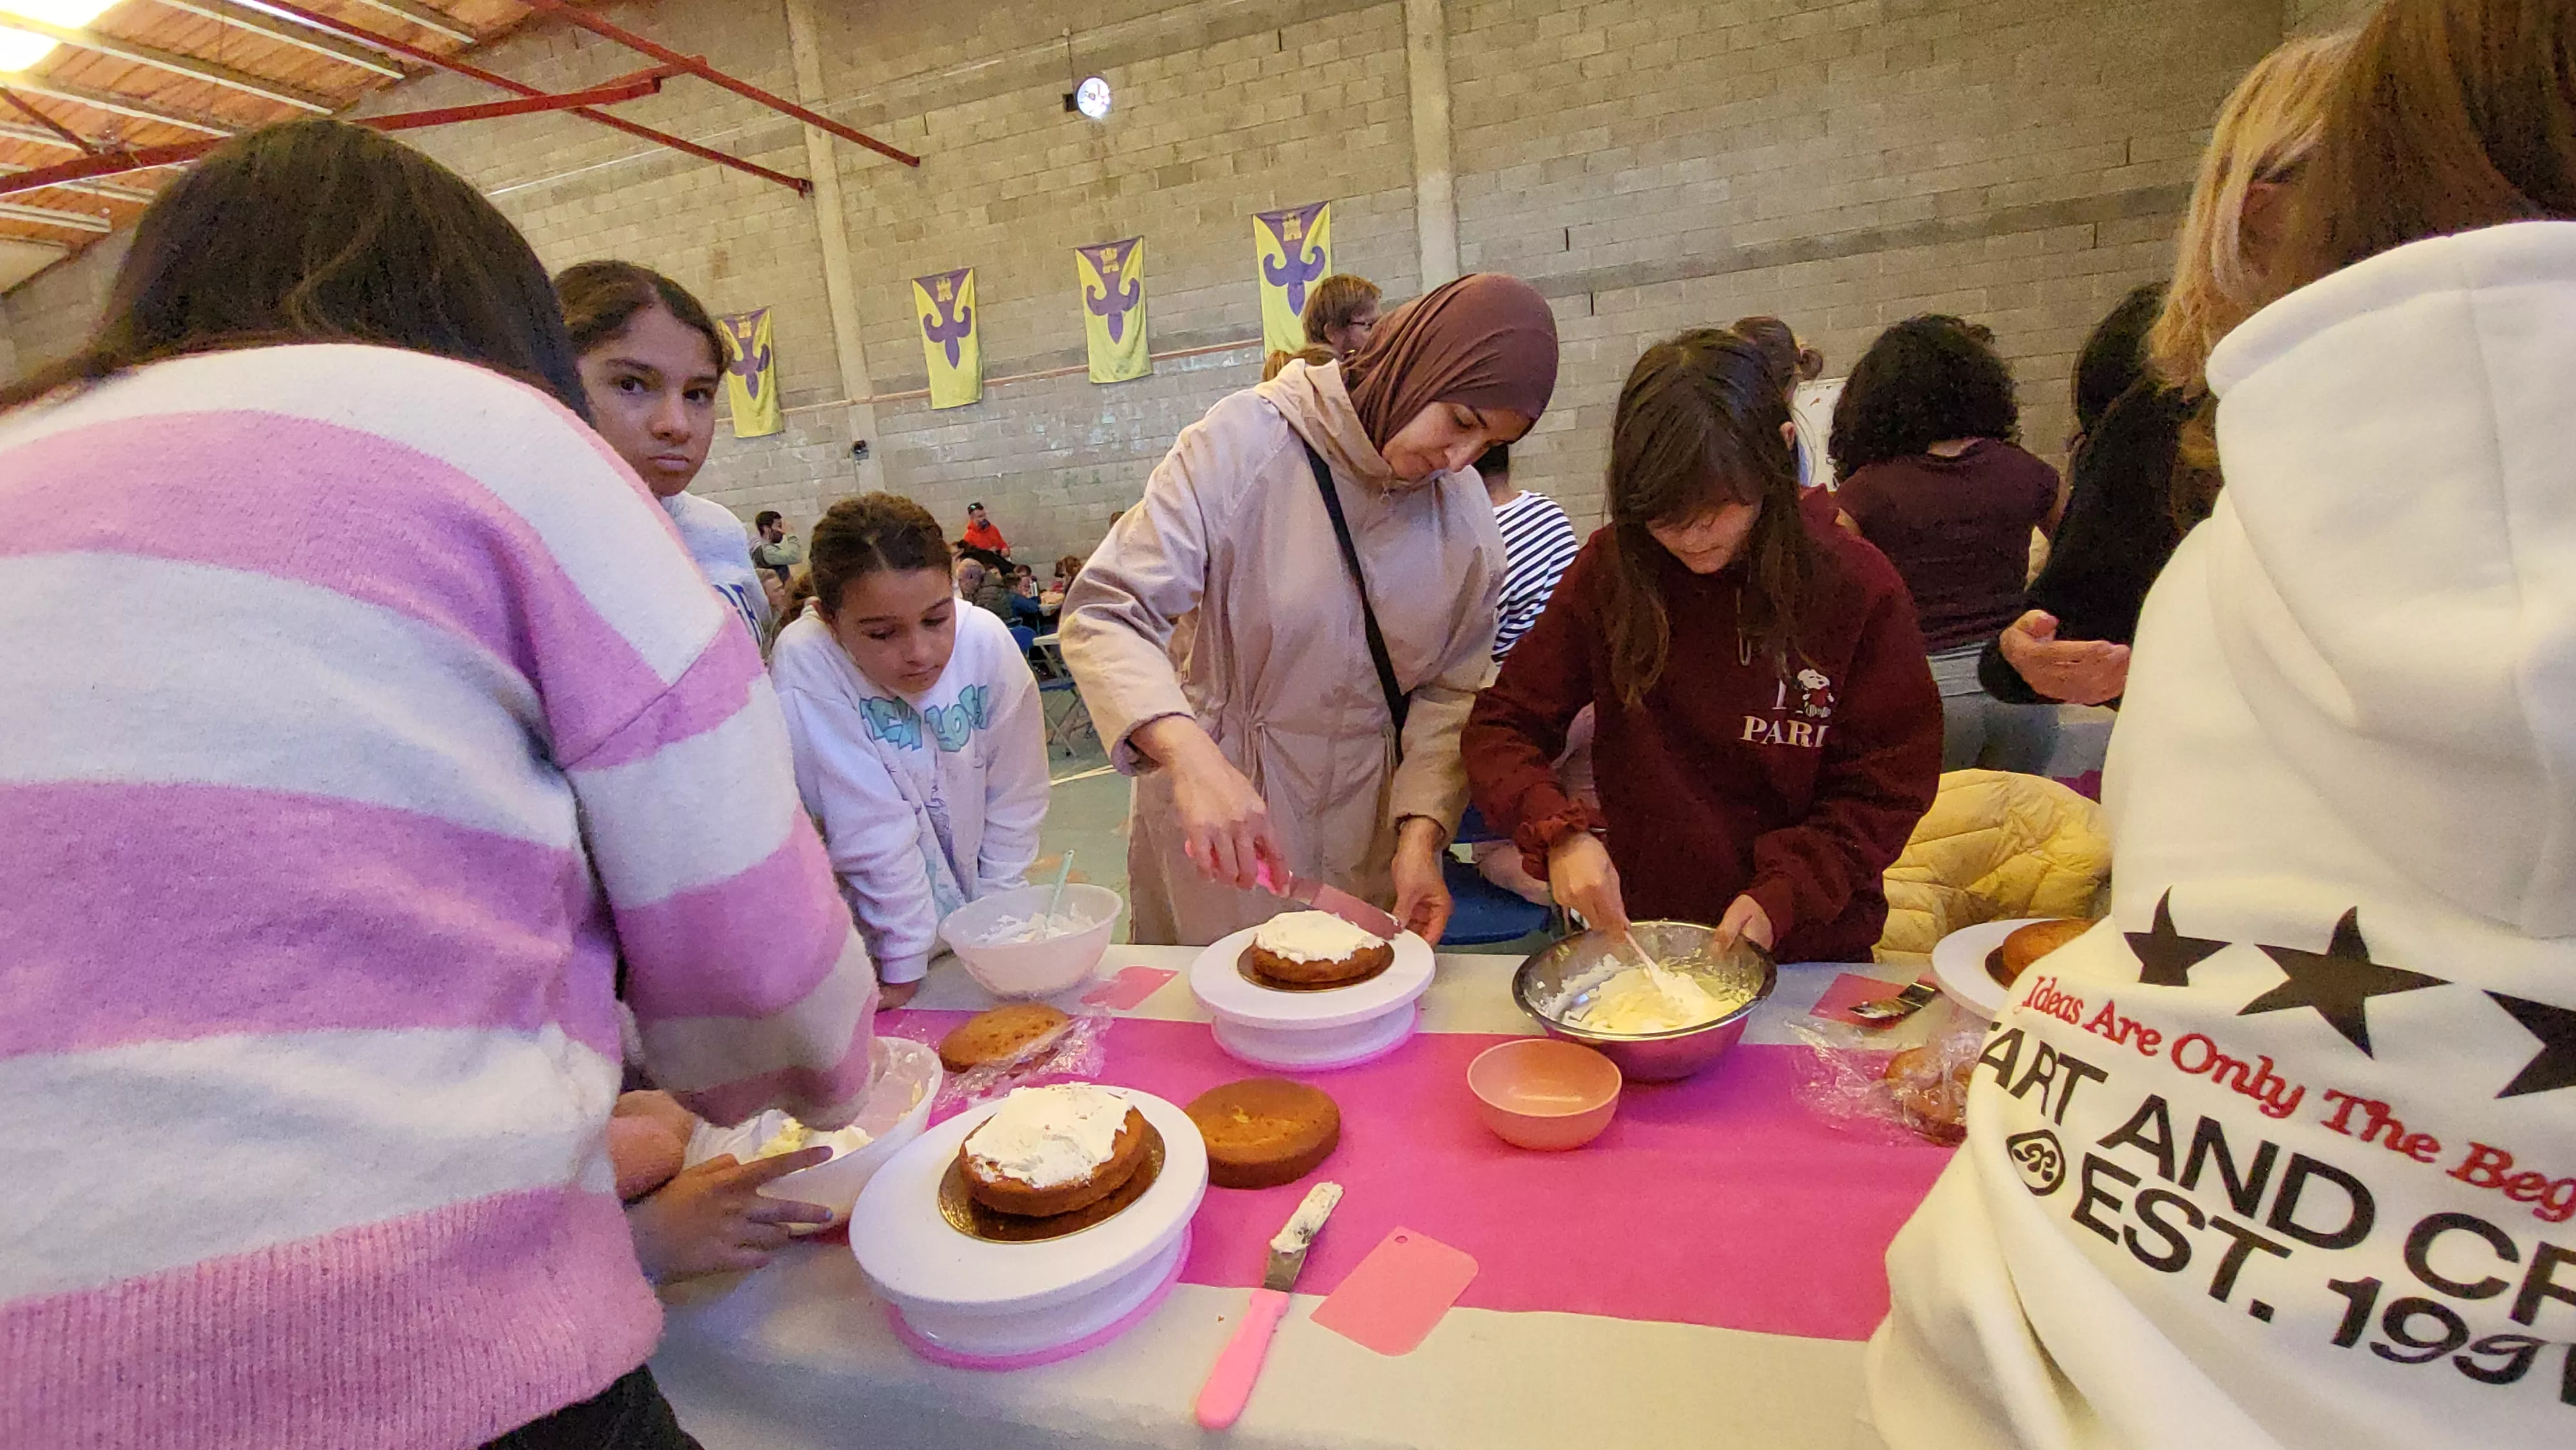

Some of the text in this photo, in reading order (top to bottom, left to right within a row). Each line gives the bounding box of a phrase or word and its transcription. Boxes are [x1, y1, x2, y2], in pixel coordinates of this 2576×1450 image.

[1978, 1021, 2109, 1127] ART
[2096, 1093, 2376, 1250] AND
[2013, 975, 2084, 1025] Ideas
[2081, 999, 2163, 1057] Are
[2170, 1032, 2307, 1119] Only
[2320, 1088, 2442, 1163] The
[2070, 1151, 2576, 1407] EST. 199
